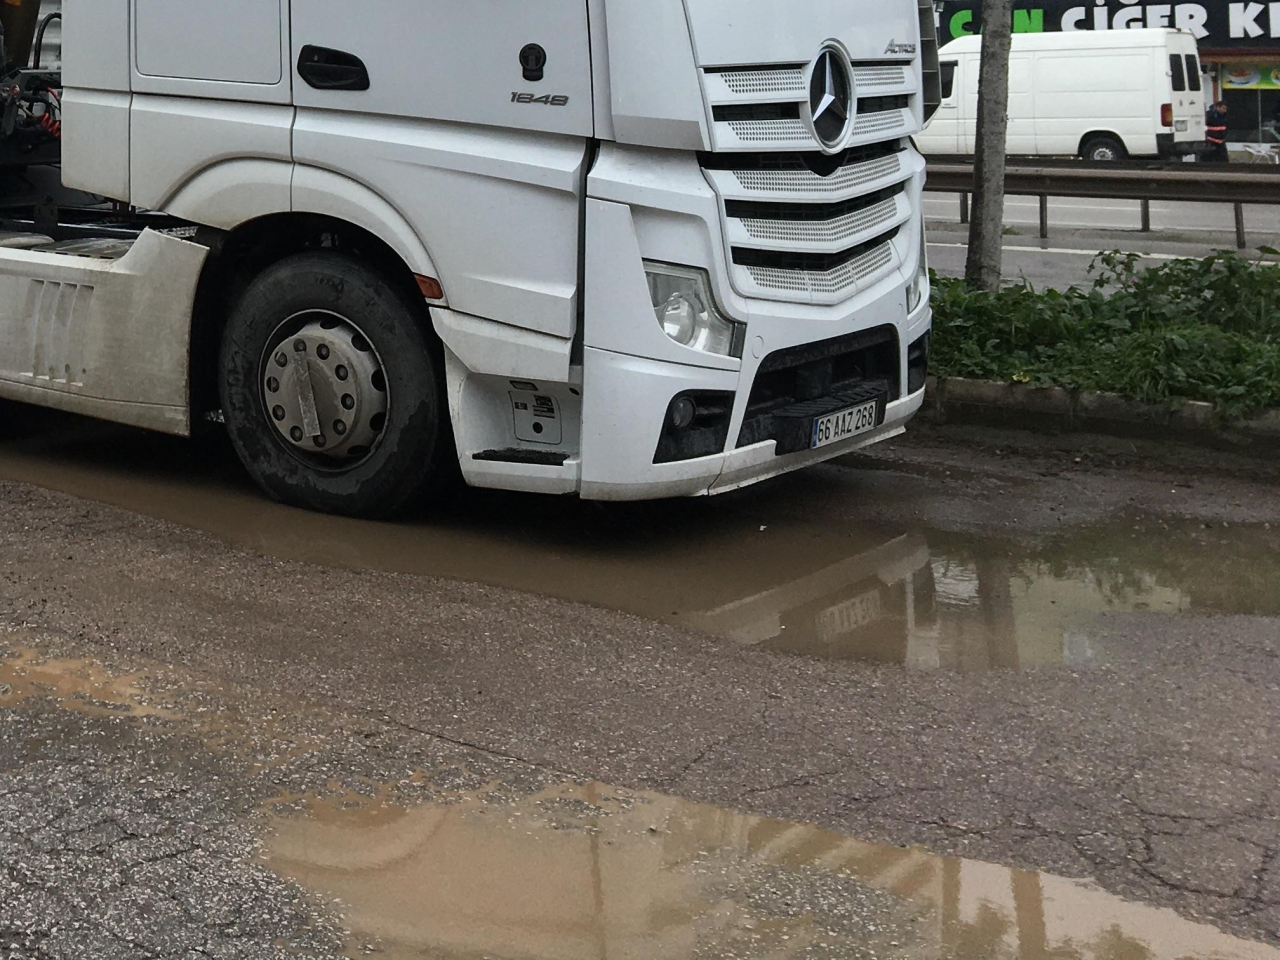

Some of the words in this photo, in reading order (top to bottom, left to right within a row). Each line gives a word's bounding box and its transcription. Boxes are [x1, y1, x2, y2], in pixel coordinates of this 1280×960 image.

[949, 8, 1044, 39] CN
[510, 91, 570, 107] 1848
[818, 418, 831, 443] 66
[833, 411, 854, 438] AAZ
[855, 404, 874, 431] 268
